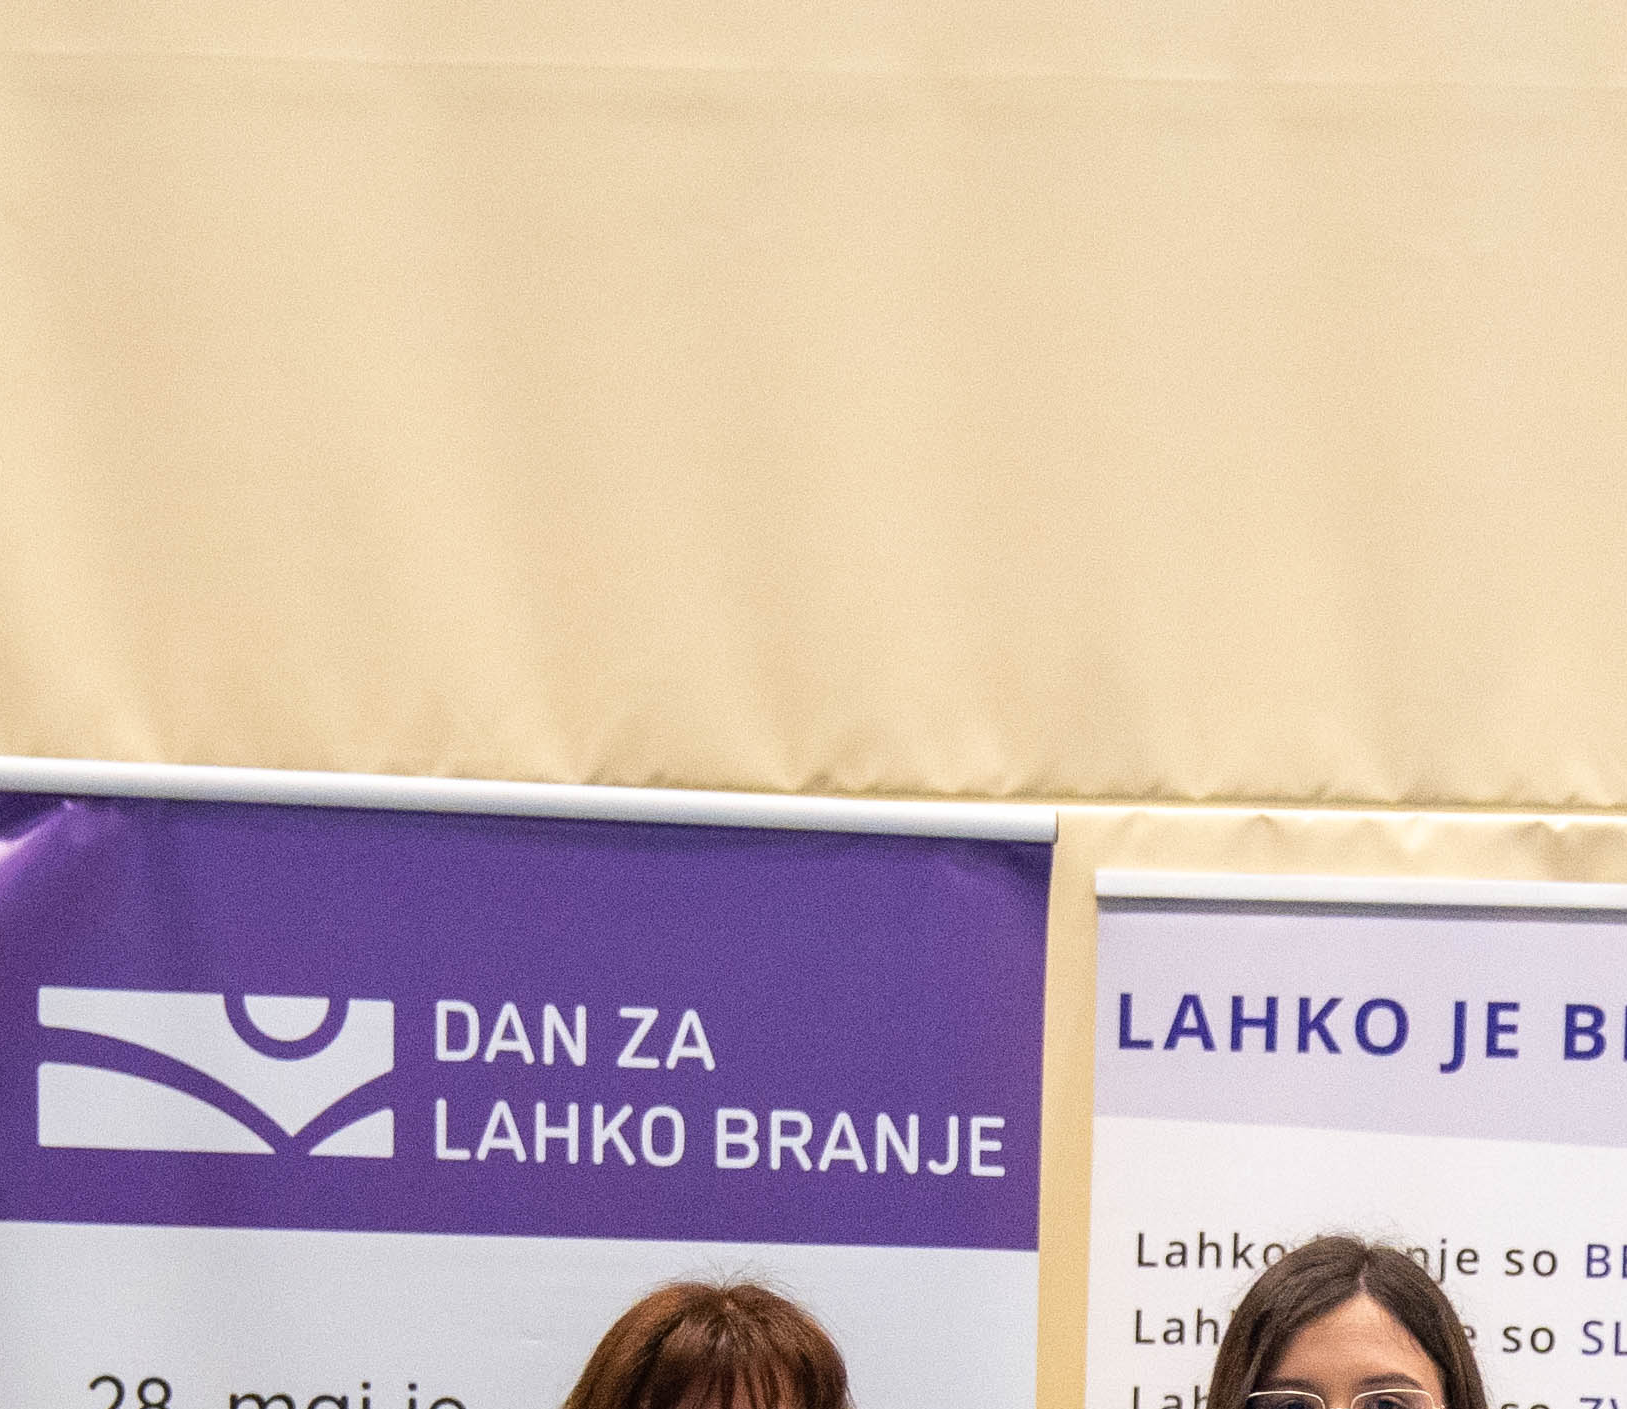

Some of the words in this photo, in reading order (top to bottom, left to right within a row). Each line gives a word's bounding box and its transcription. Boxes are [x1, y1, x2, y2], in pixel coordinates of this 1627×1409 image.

[433, 999, 588, 1067] DAN
[616, 1006, 716, 1073] ZA
[1117, 992, 1412, 1057] LAHKO
[1438, 999, 1523, 1075] JE
[434, 1097, 686, 1168] LAHKO
[715, 1108, 1007, 1179] BRANJE
[1504, 1245, 1560, 1278] so
[1134, 1308, 1221, 1345] Lah
[1502, 1322, 1558, 1357] so
